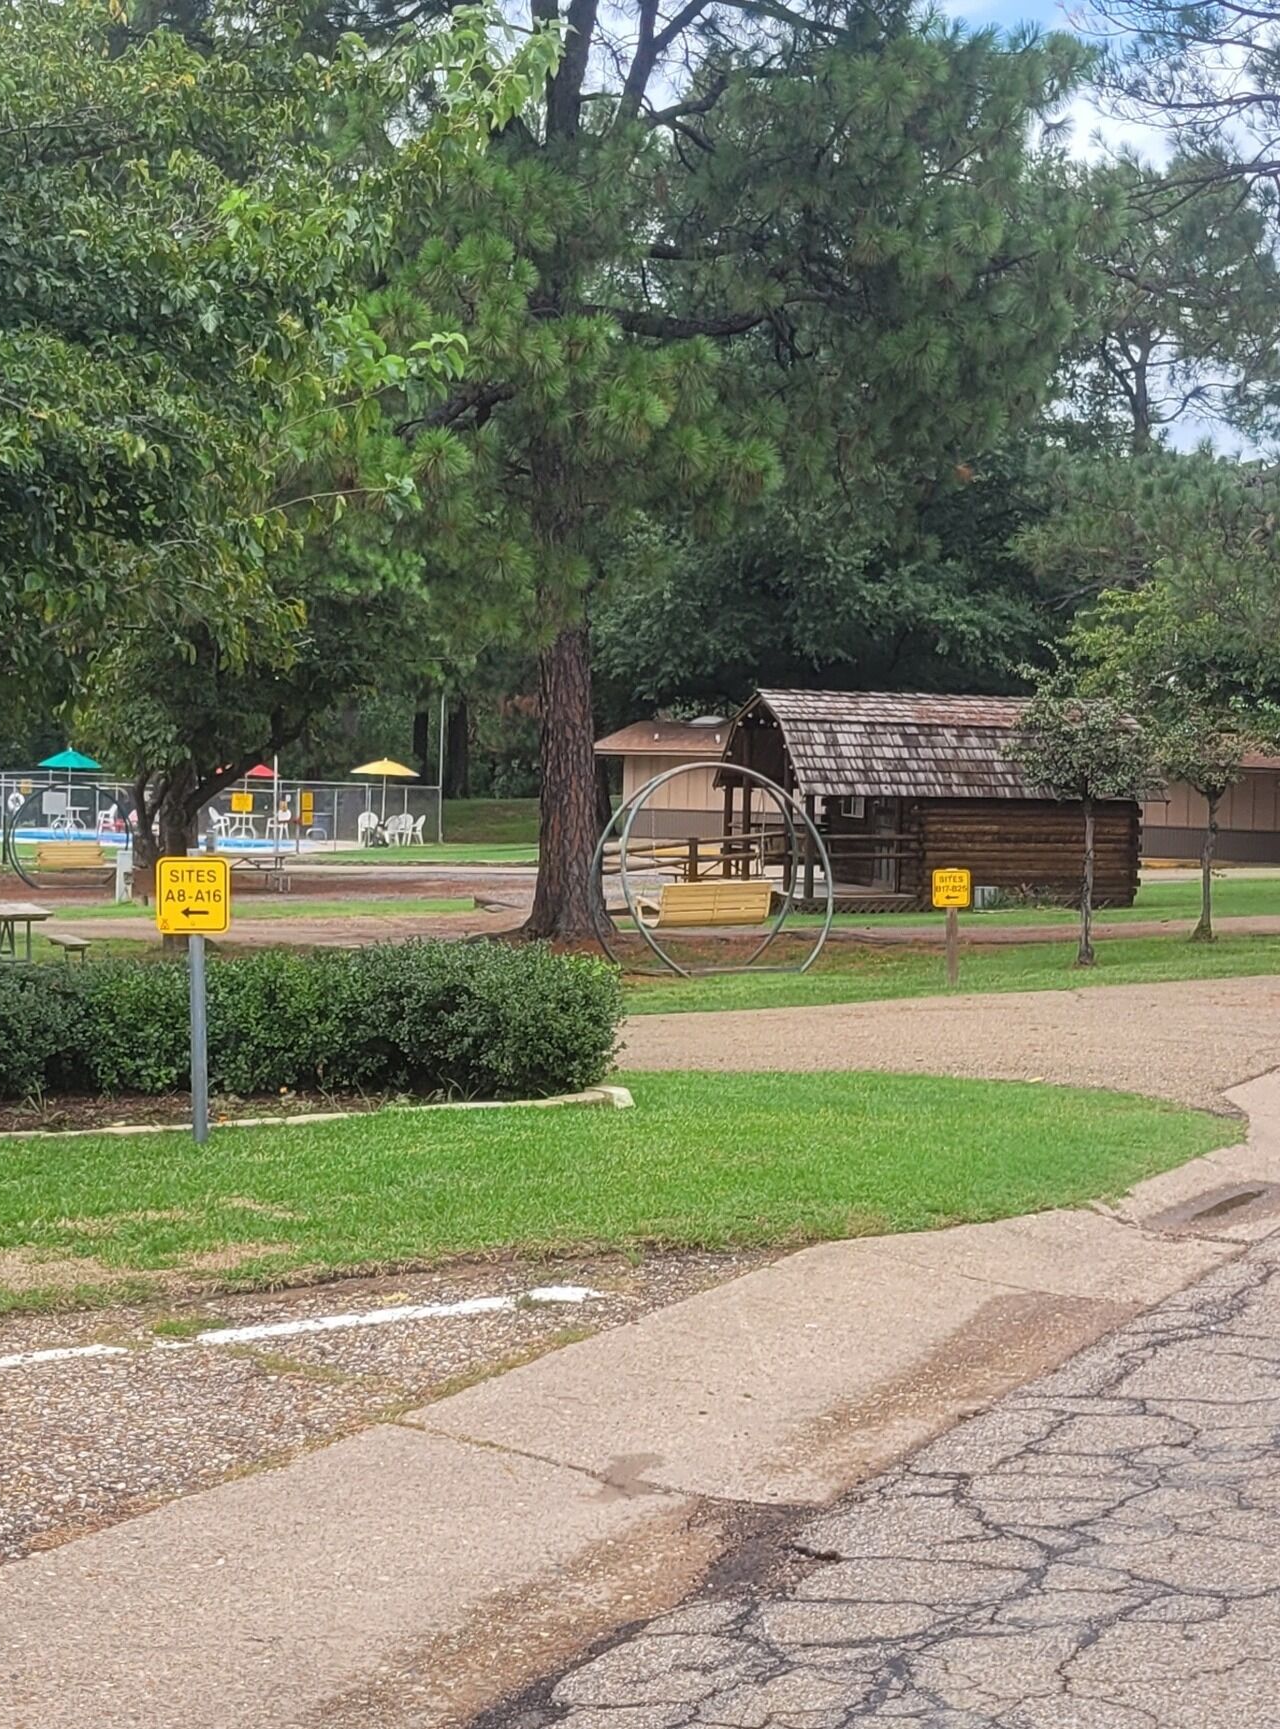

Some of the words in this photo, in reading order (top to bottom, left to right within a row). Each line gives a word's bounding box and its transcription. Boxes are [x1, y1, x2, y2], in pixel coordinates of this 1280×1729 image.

[169, 869, 217, 883] SITES
[939, 875, 964, 883] SITES
[164, 888, 222, 903] A8-A16
